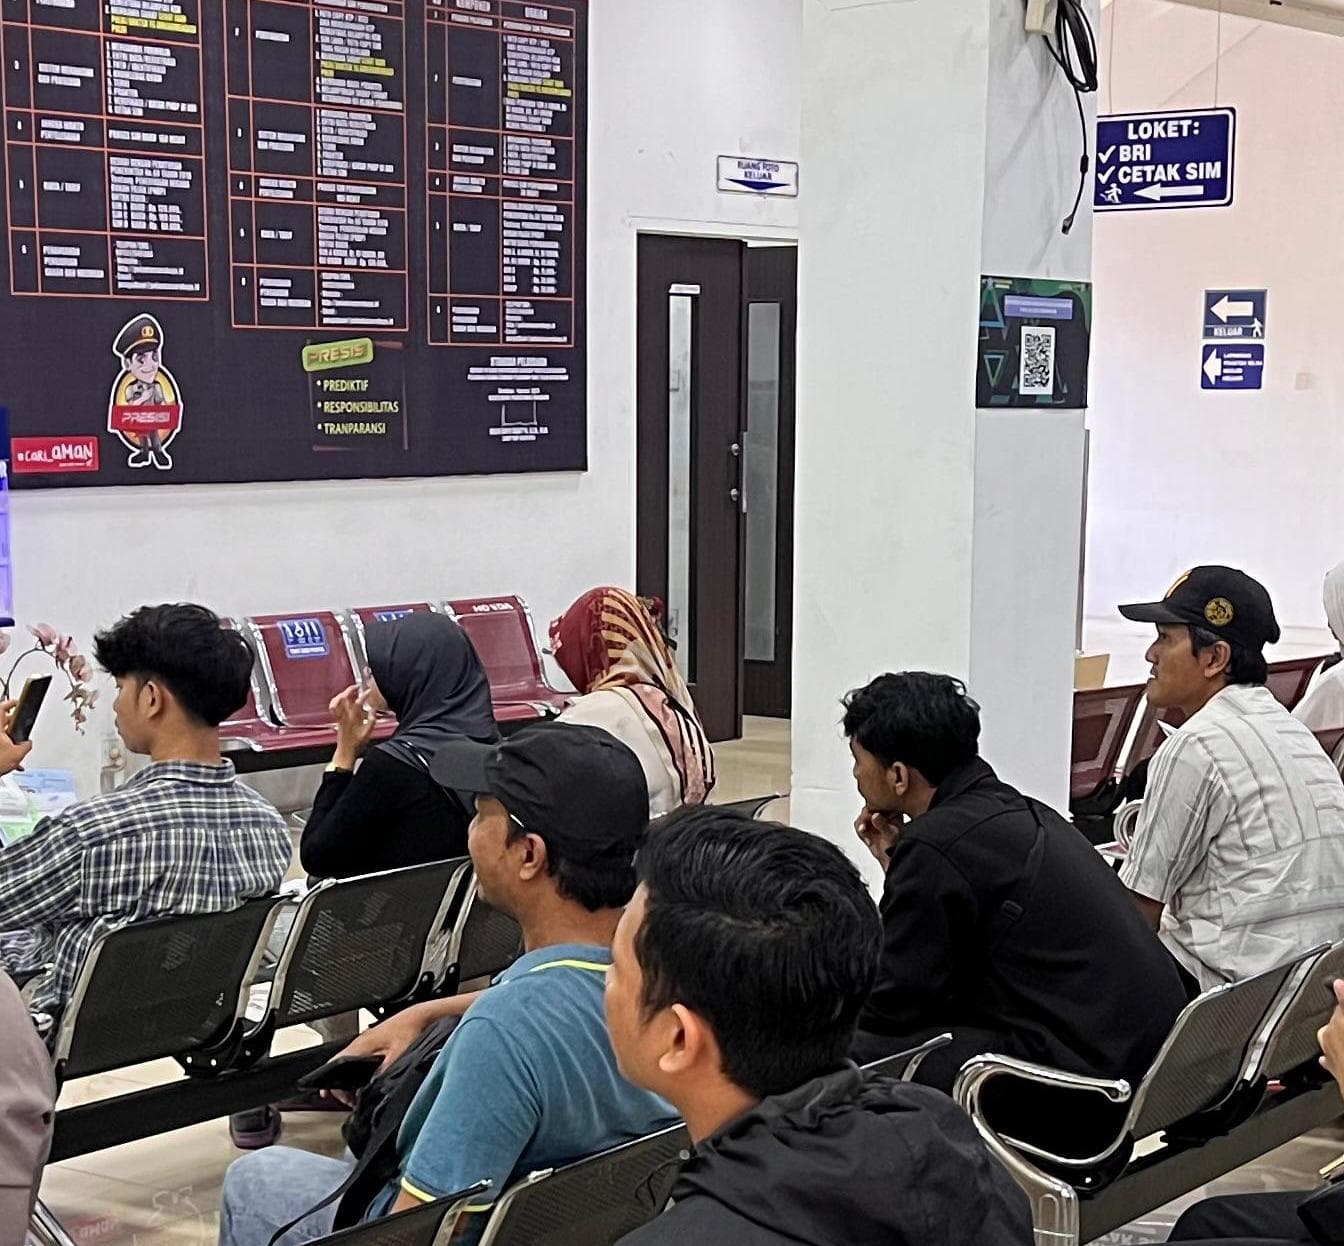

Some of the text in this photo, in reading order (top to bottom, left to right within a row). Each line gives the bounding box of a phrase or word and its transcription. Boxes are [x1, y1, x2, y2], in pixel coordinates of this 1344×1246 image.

[1127, 119, 1200, 140] LOKET:
[1119, 143, 1151, 162] BRI
[1118, 161, 1222, 183] CETAK SIM
[323, 379, 369, 392] PREDIKTIF
[323, 401, 399, 414] RESPONSIBILITAS
